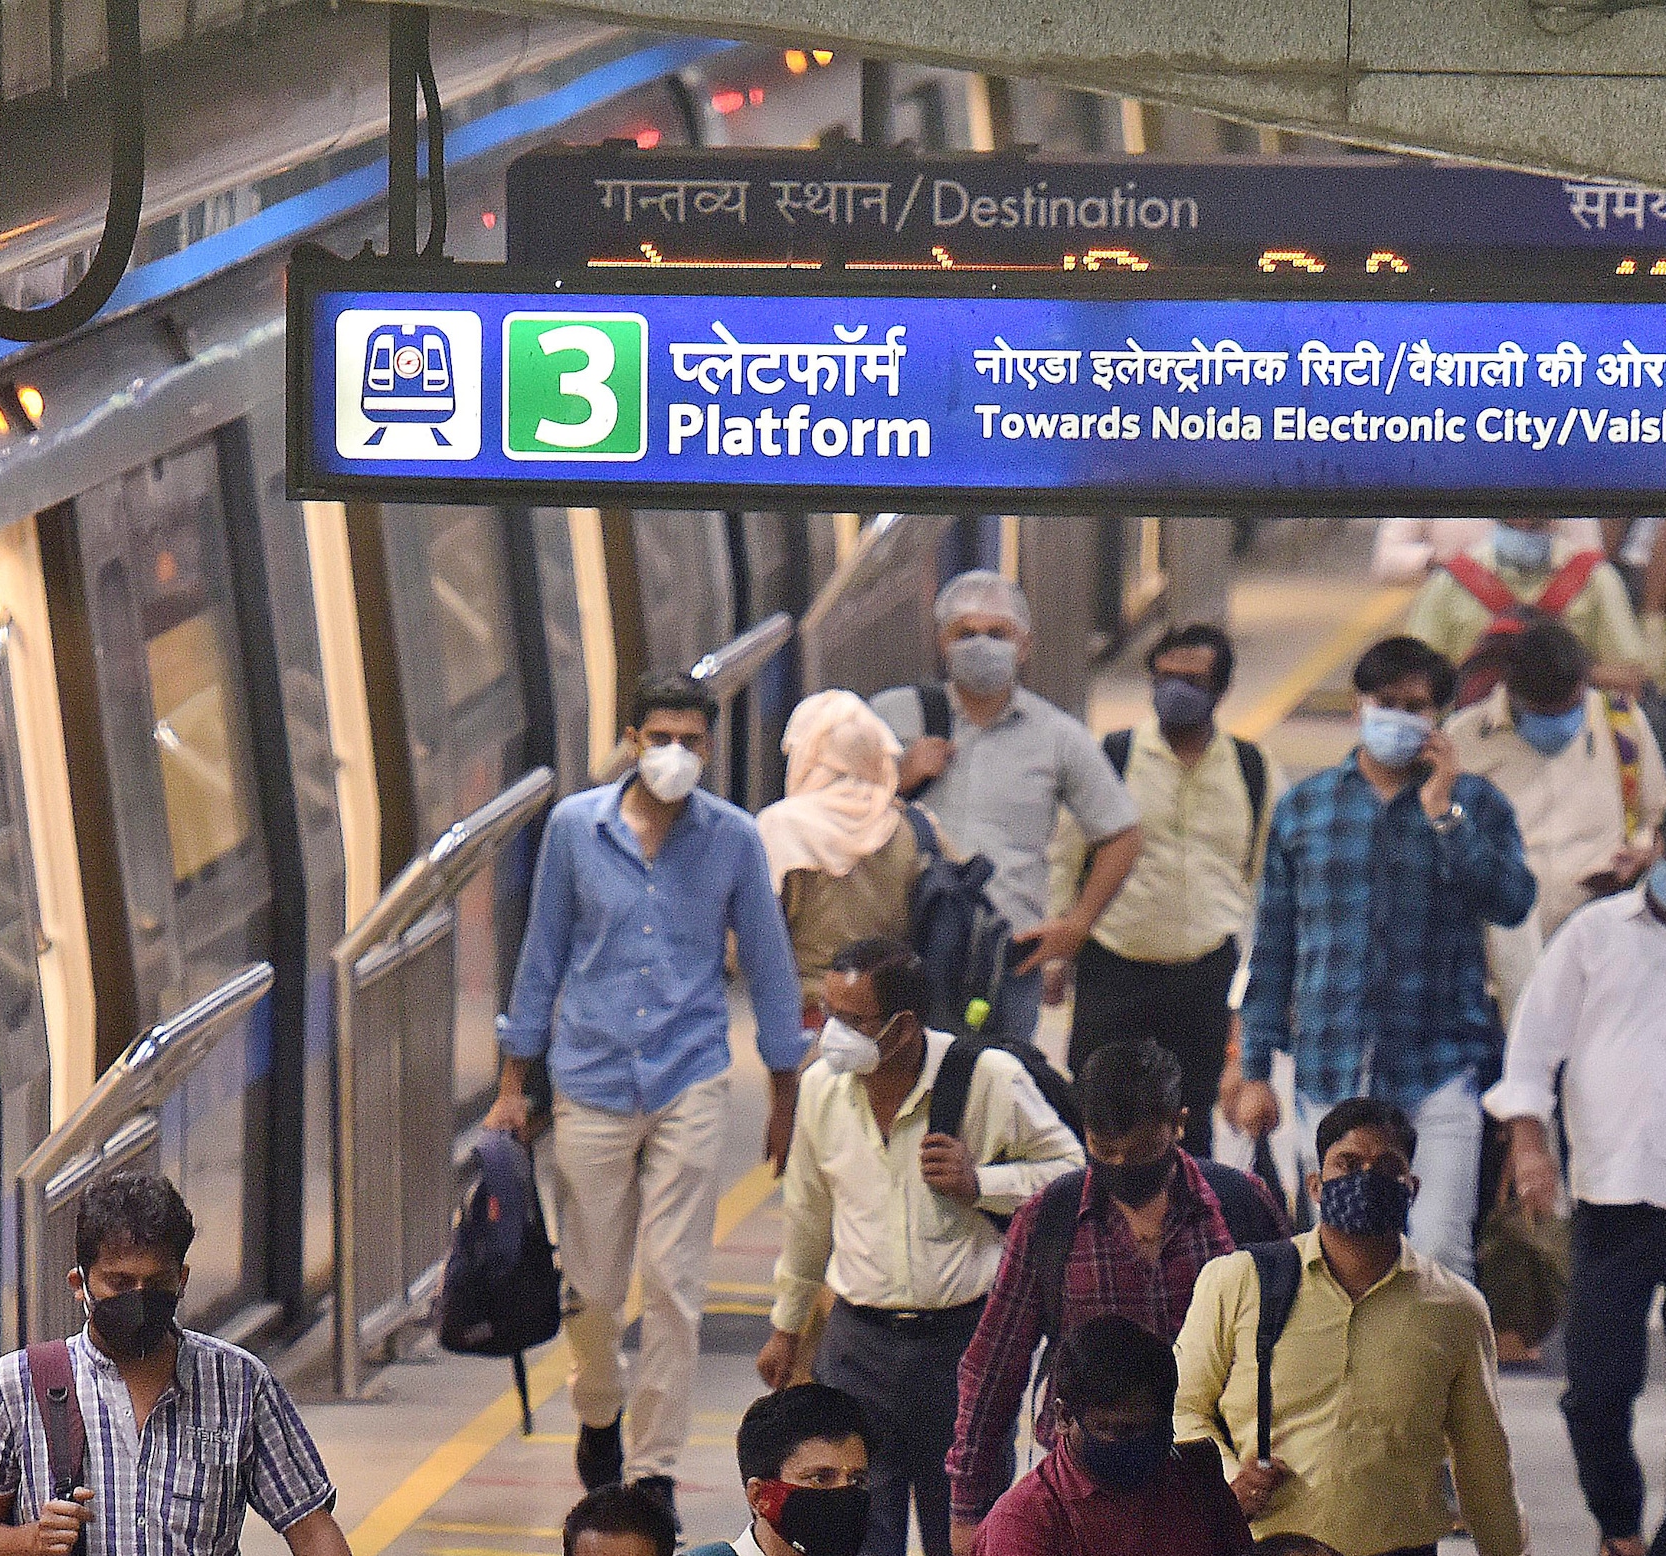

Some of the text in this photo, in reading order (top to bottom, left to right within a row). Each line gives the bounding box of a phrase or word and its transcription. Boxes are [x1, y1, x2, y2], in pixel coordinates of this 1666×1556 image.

[595, 178, 751, 223] गन्तव्य
[668, 319, 907, 397] प्लेटफॉर्म
[973, 336, 1082, 390] नोएडा
[1089, 337, 1289, 394] इलेक्ट्रोनिक
[1535, 339, 1588, 388] की
[534, 323, 619, 450] 3
[667, 402, 932, 457] Platform
[973, 403, 1141, 441] Towards
[1151, 405, 1262, 442] Noida
[1272, 406, 1465, 443] Electronic
